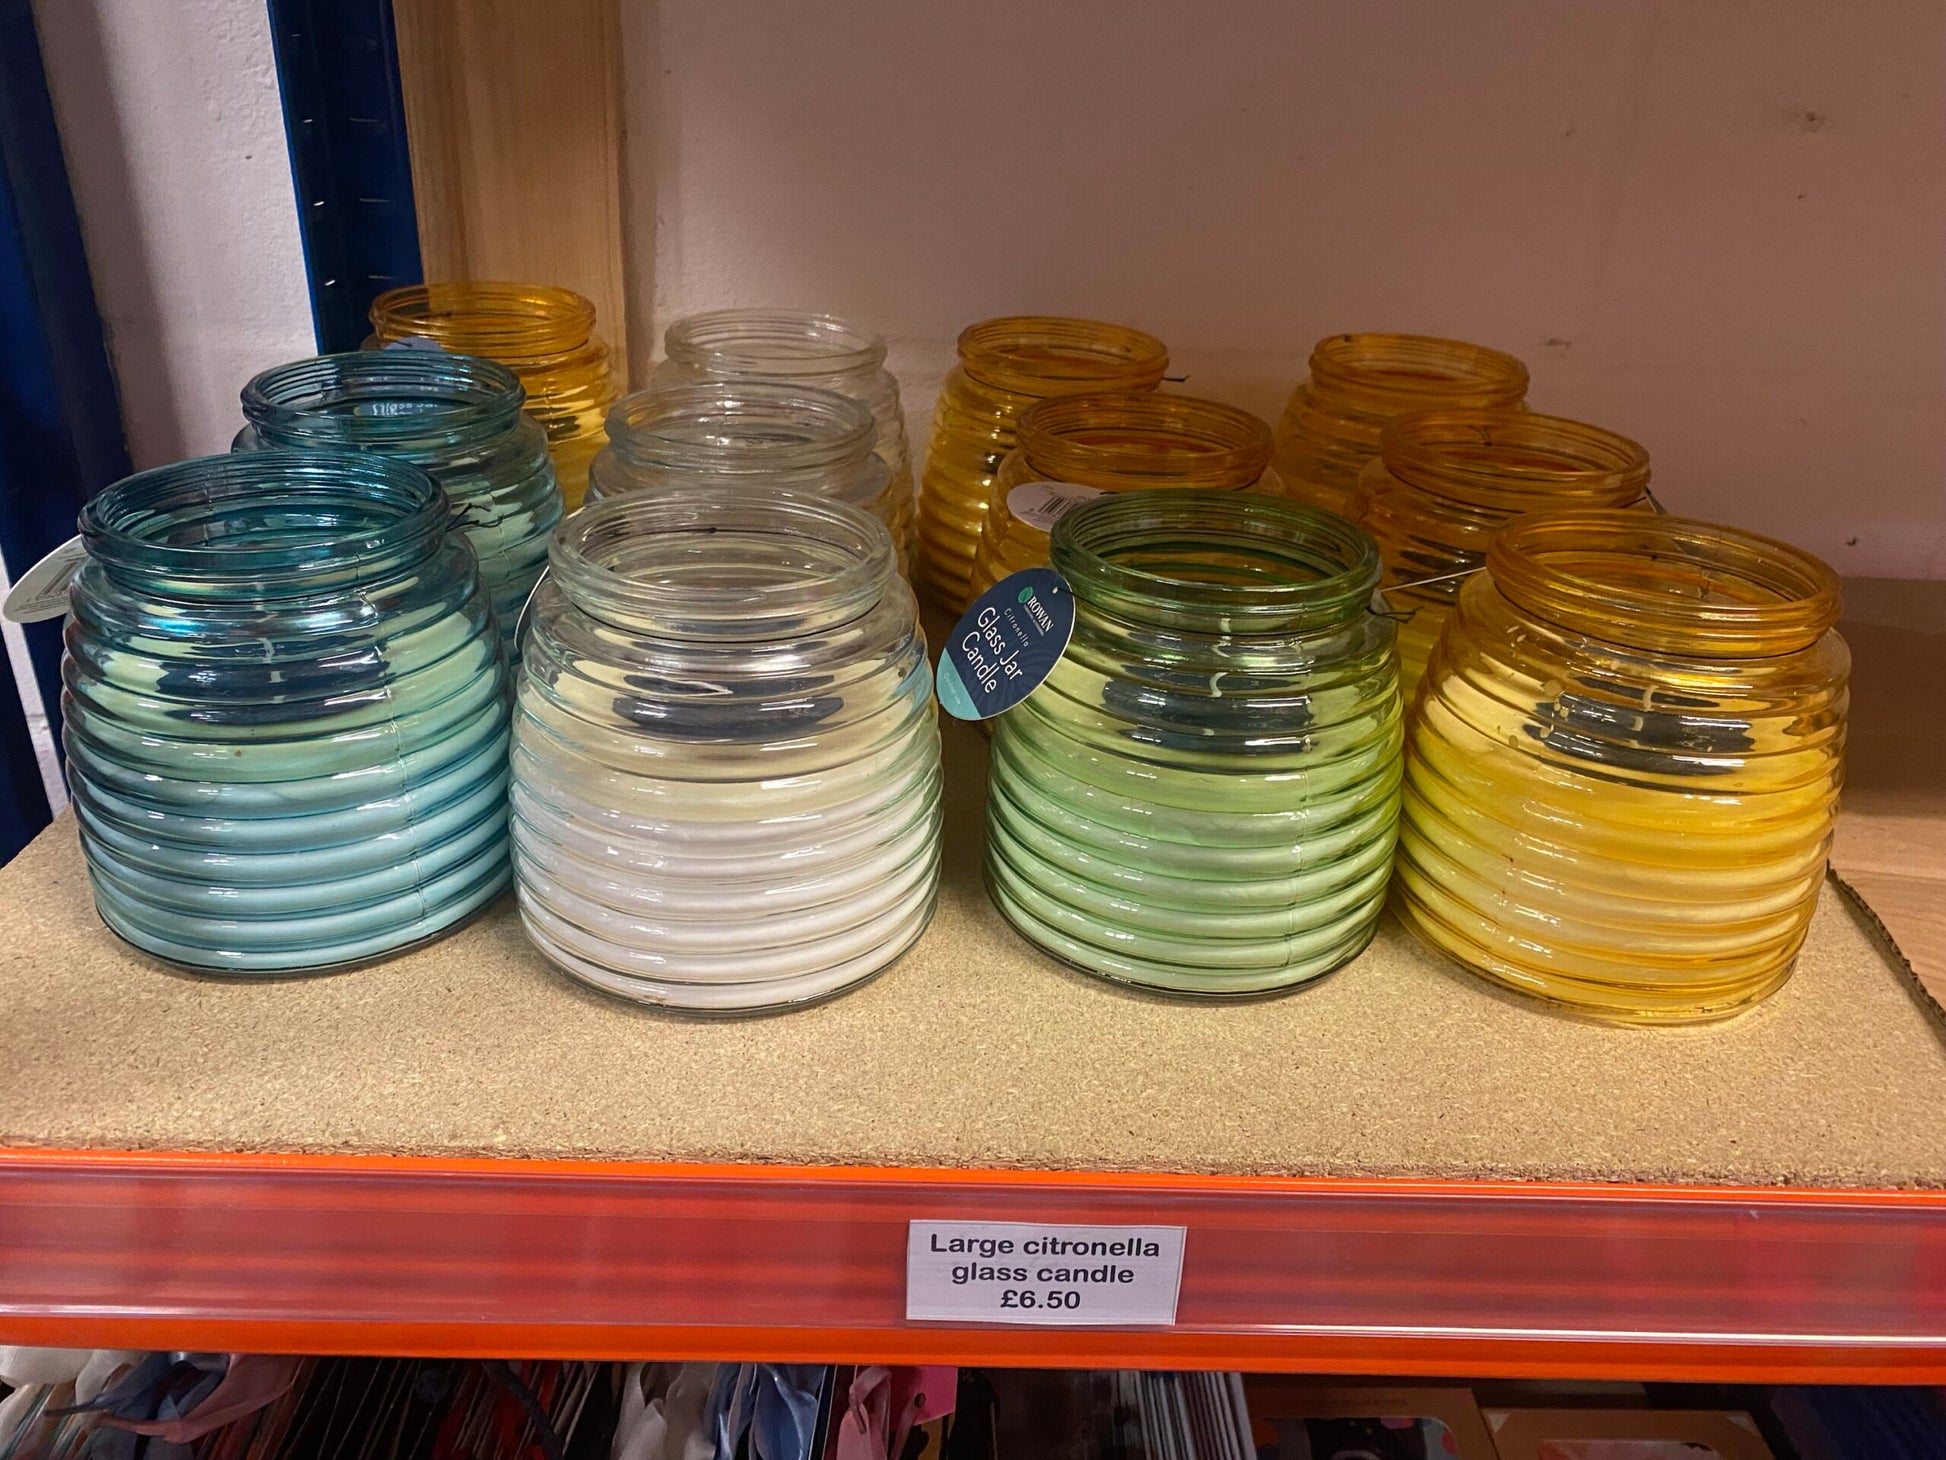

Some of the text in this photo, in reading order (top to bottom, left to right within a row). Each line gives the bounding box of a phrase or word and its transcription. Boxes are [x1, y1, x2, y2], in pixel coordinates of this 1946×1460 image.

[1004, 608, 1030, 647] Citronella
[1027, 596, 1054, 633] ROWAN
[977, 606, 1023, 680] Glass Jar
[962, 631, 1000, 694] Candle
[930, 1233, 1160, 1258] Large citronella
[951, 1262, 1135, 1285] glass candle
[1000, 1289, 1081, 1310] £6.50
